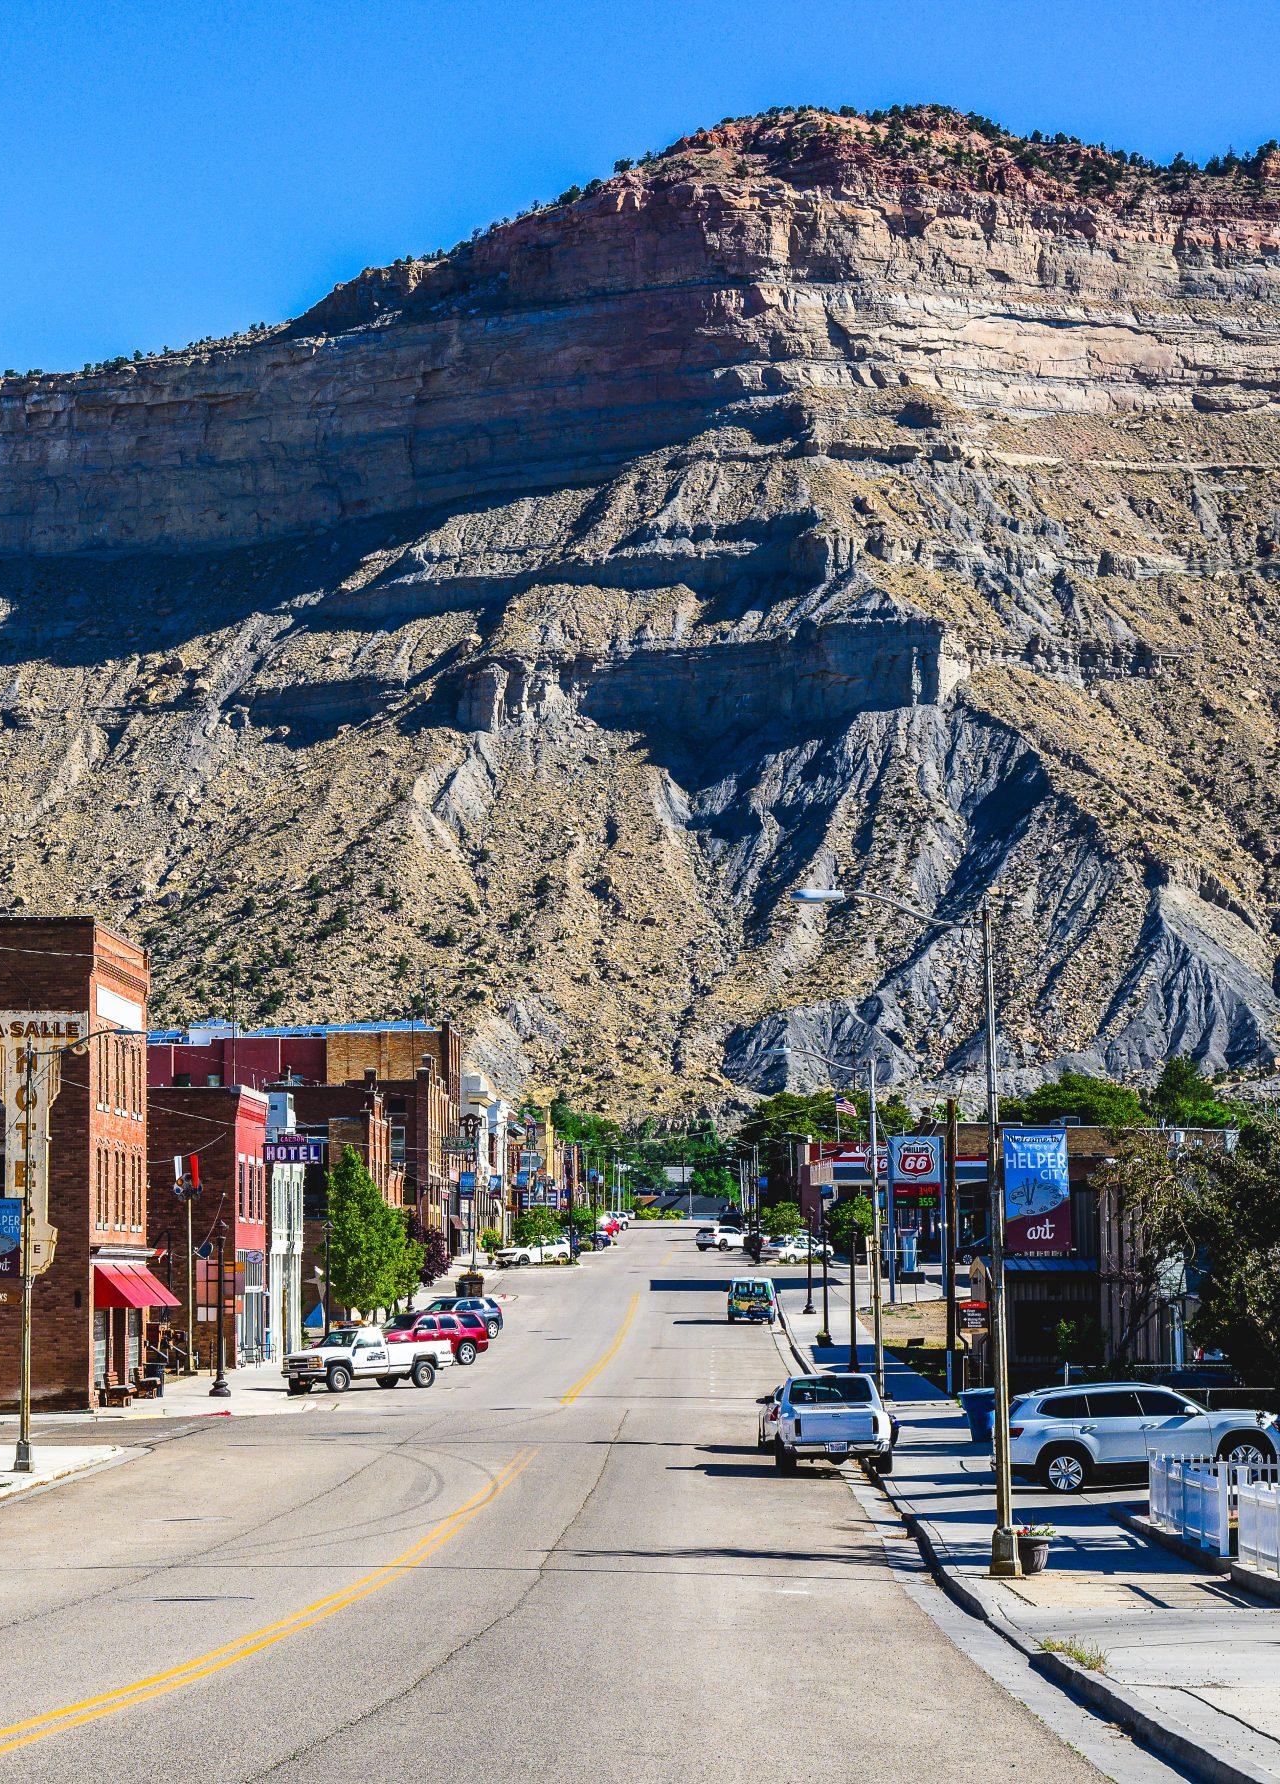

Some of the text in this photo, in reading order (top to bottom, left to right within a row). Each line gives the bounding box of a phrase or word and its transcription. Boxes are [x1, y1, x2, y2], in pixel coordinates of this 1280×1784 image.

[10, 1020, 81, 1038] SALLE
[15, 1047, 37, 1227] HOTE
[1008, 1134, 1061, 1143] Welcome to
[266, 1146, 319, 1161] HOTEL
[903, 1146, 929, 1154] PHILLIPS
[904, 1156, 927, 1170] 66
[1005, 1153, 1067, 1169] HELPER
[1040, 1169, 1067, 1180] CITY
[3, 1226, 20, 1234] CITY
[1026, 1218, 1056, 1240] art
